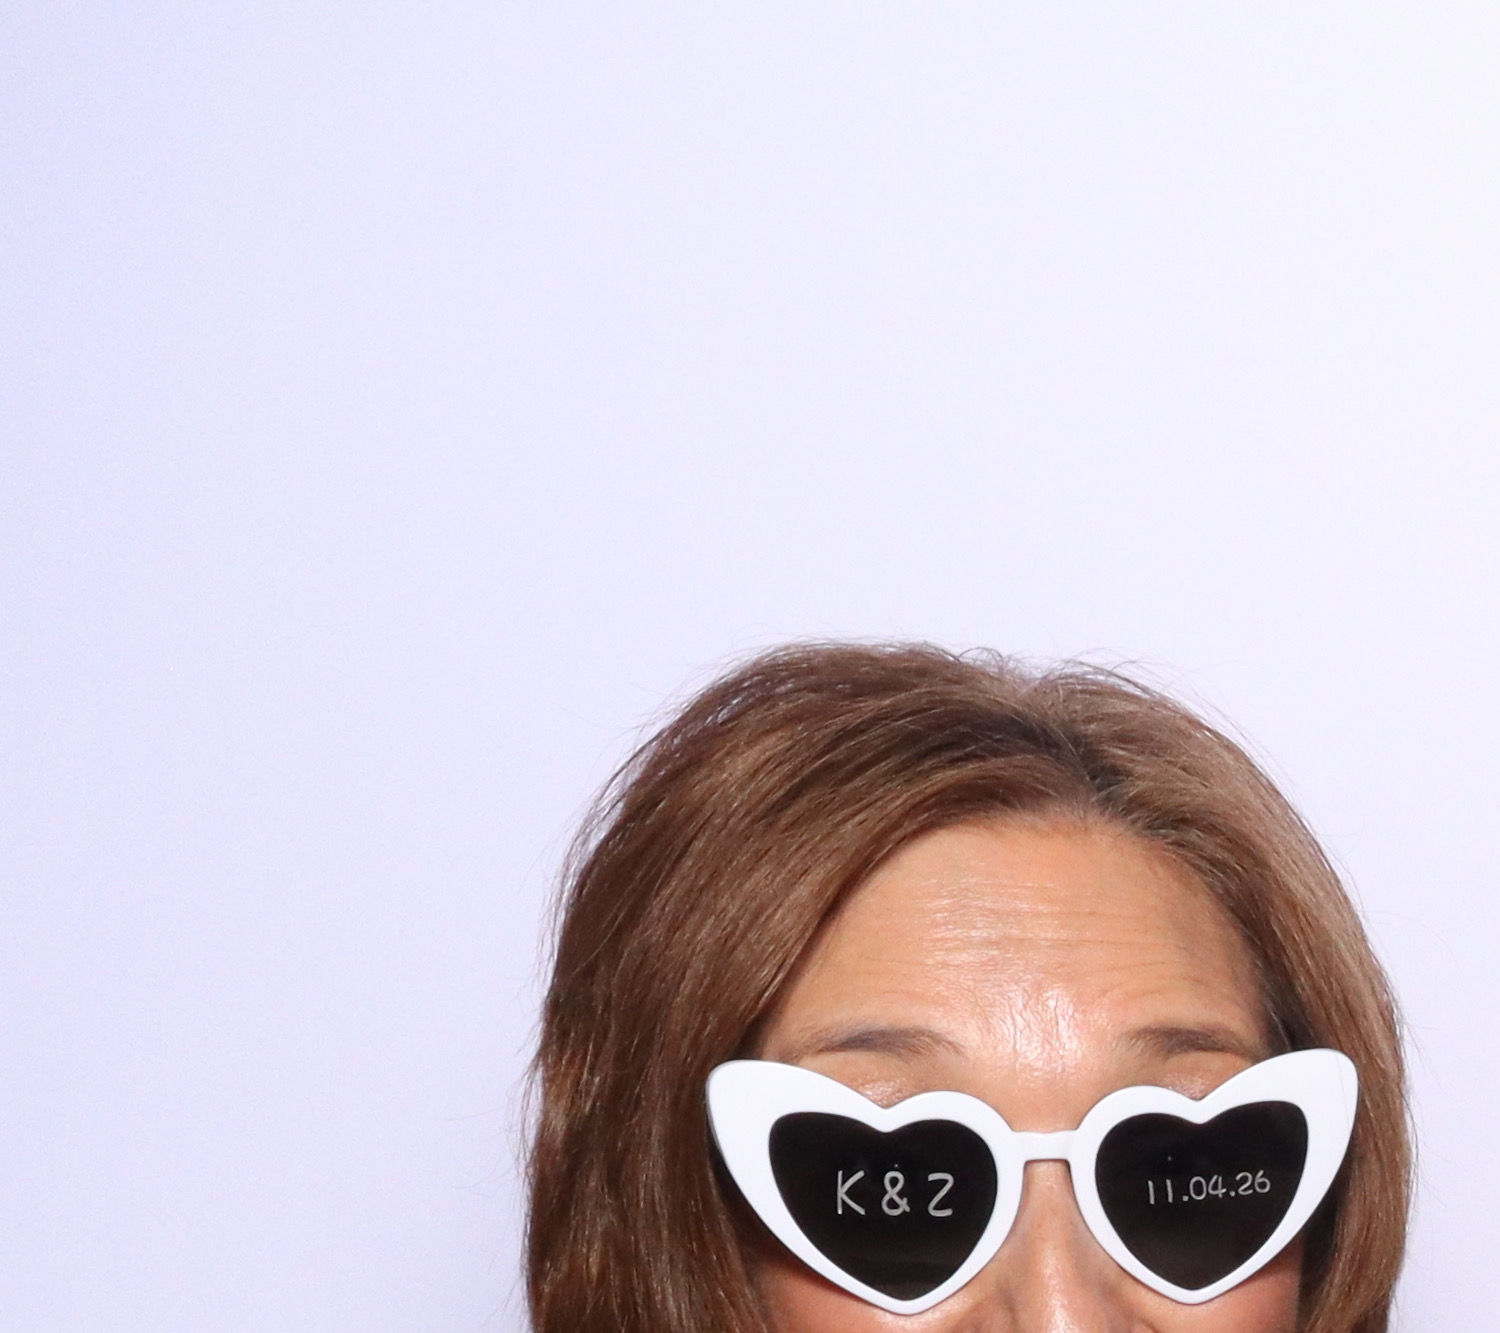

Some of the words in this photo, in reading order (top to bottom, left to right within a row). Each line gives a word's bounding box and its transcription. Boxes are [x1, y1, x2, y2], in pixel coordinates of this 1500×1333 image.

[835, 1169, 867, 1217] K
[880, 1169, 912, 1217] &
[1146, 1168, 1272, 1206] 11.04.26
